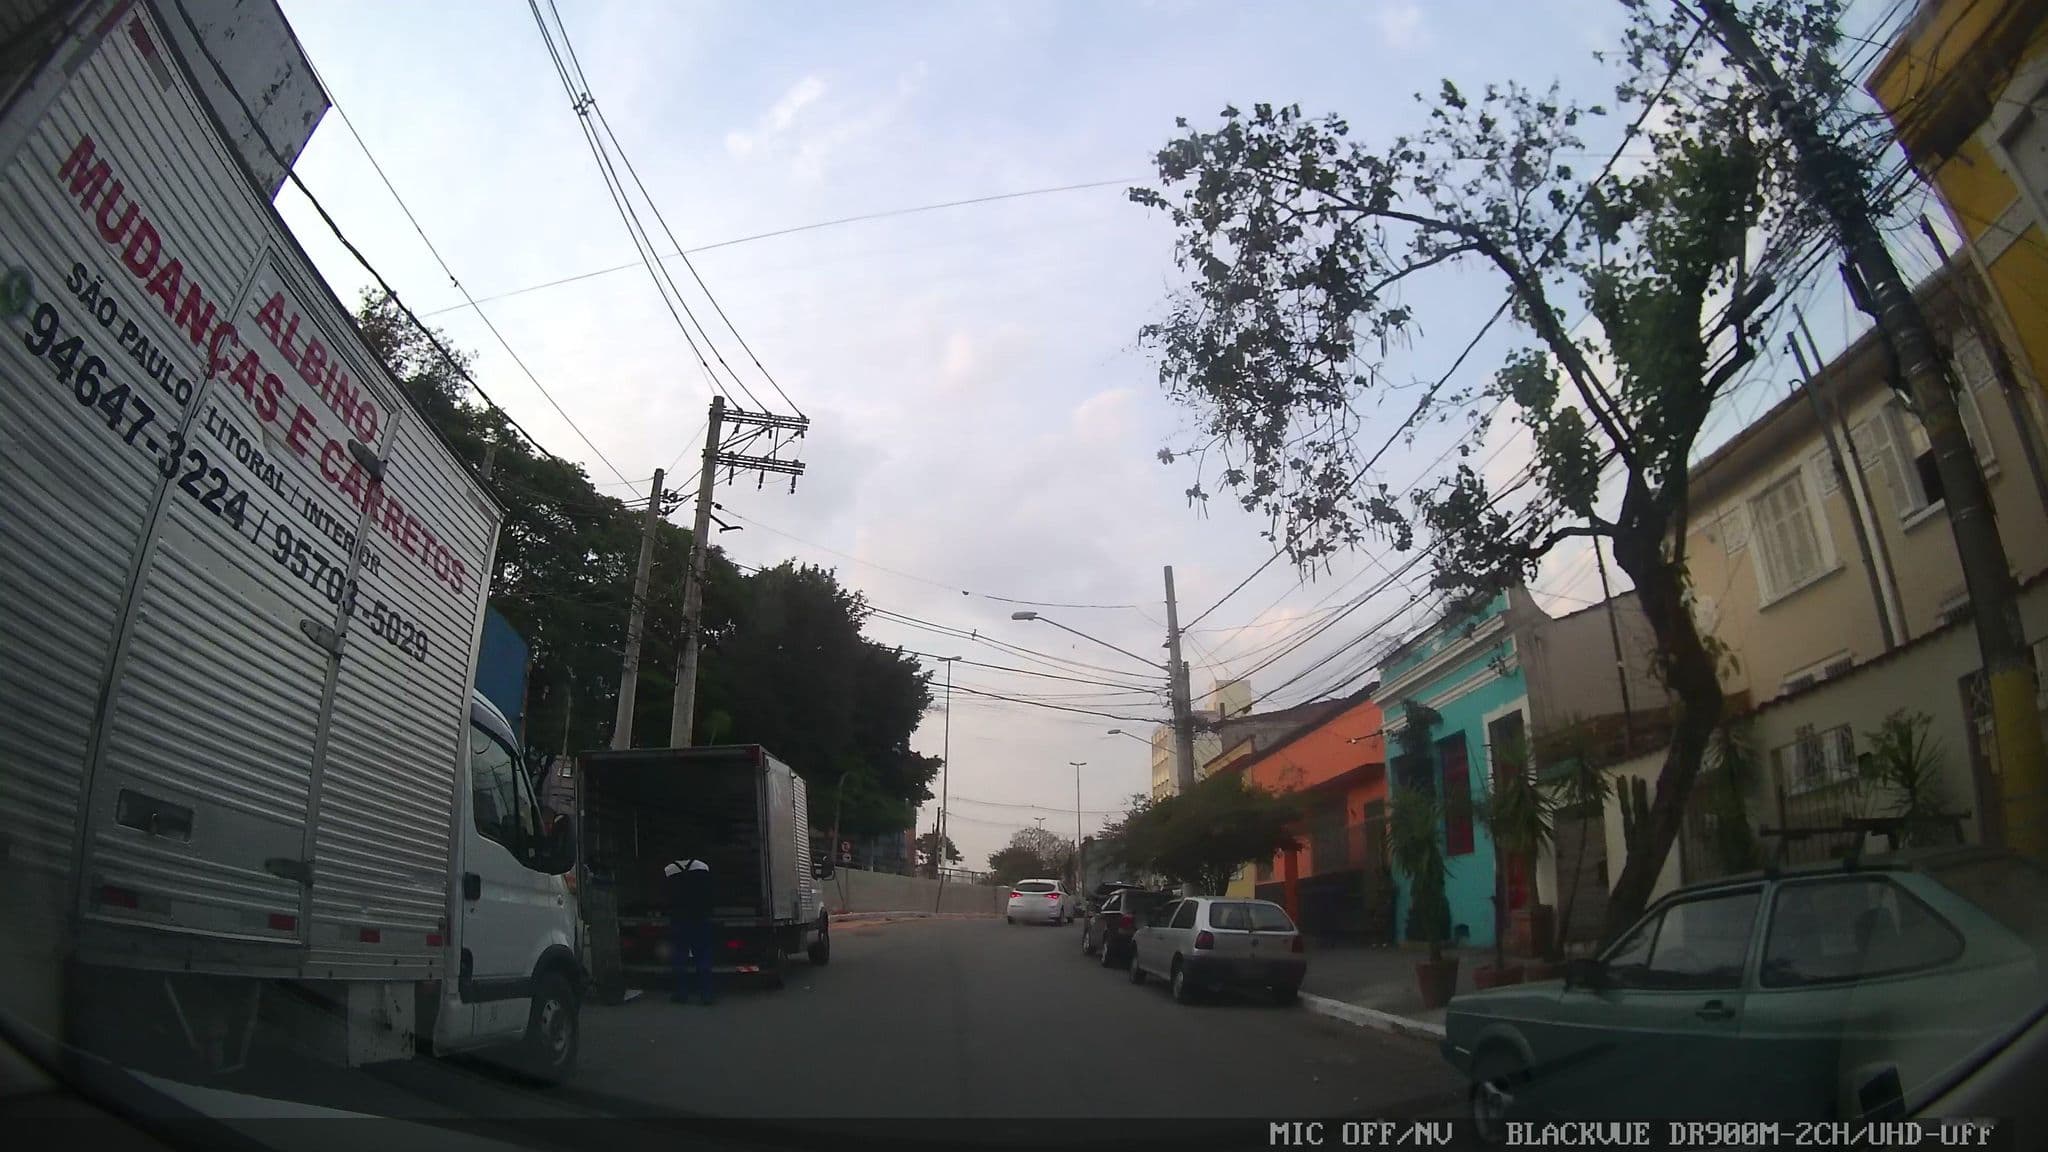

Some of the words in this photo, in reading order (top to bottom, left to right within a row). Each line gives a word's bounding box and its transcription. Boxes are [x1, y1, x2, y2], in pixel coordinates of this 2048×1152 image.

[24, 302, 249, 531] 94647-3224
[58, 133, 284, 422] MUDANÇAS
[286, 404, 317, 457] E
[320, 438, 466, 594] CARRETOS
[66, 262, 118, 328] SÃO
[118, 319, 193, 406] PAULO
[205, 406, 286, 498] LITORAL
[256, 291, 377, 443] ALBINO
